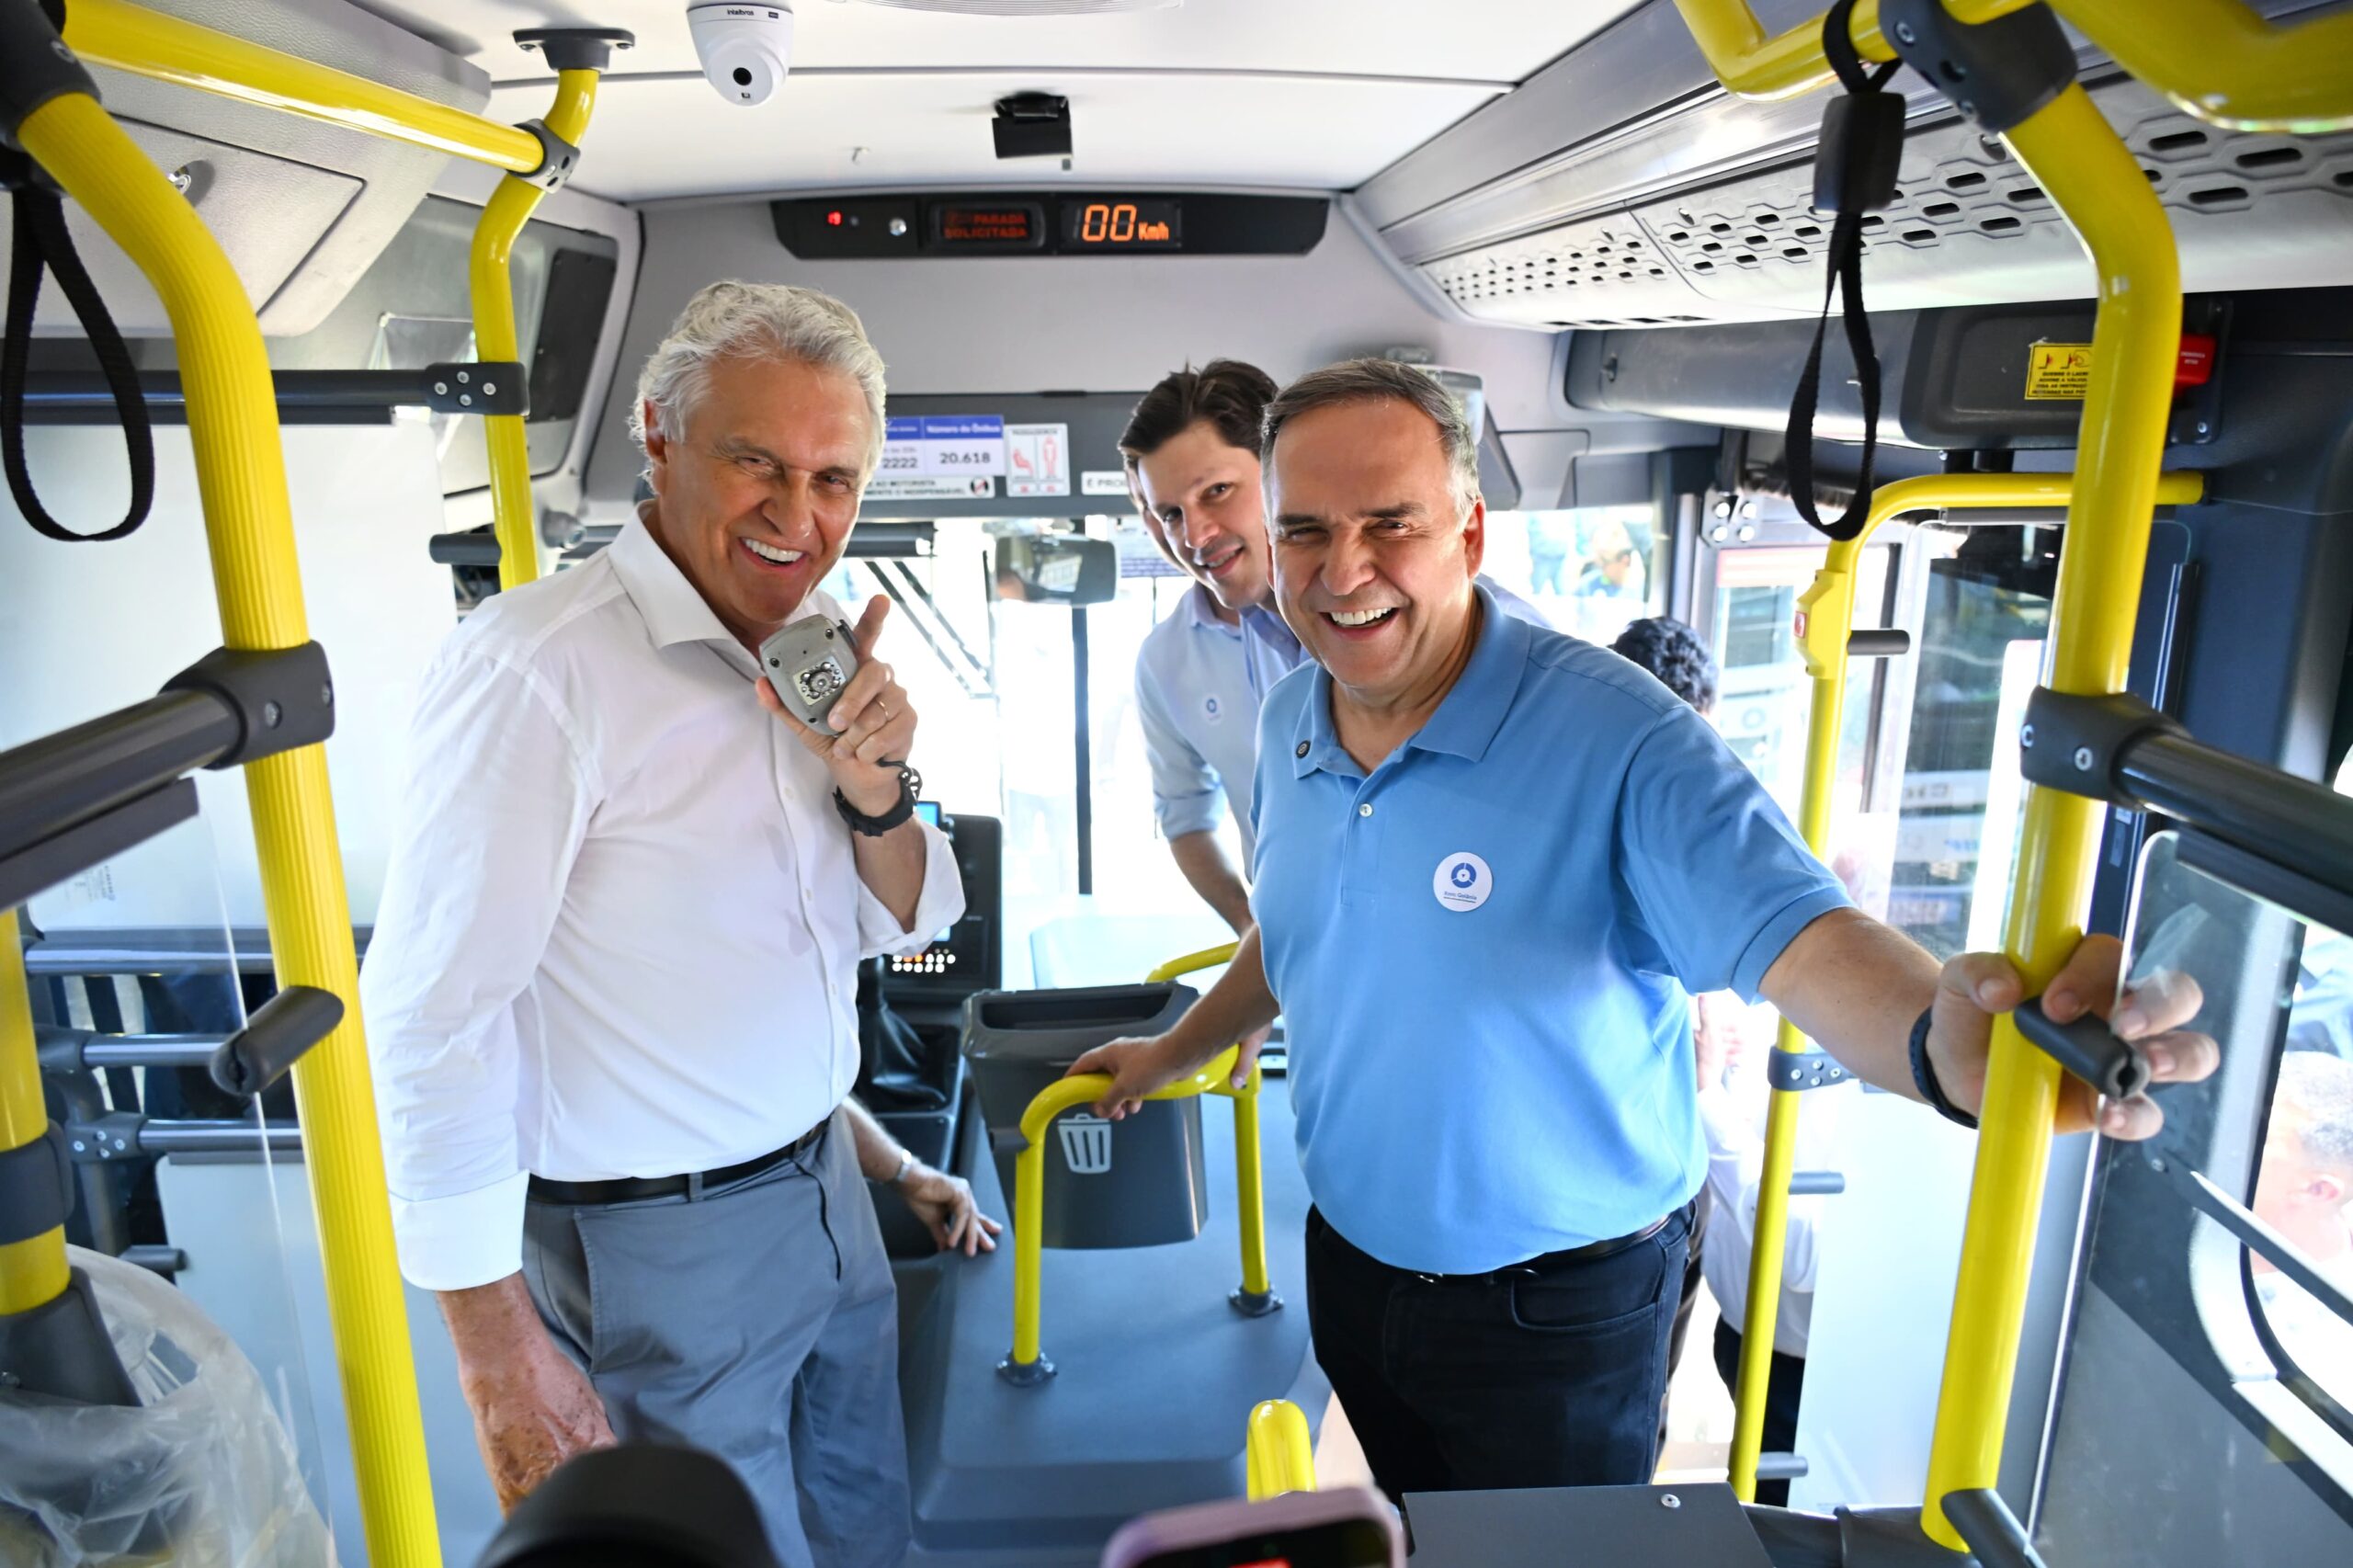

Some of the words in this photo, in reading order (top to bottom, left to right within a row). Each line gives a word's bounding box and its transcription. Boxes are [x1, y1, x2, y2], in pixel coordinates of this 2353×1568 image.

[1082, 204, 1137, 242] 00
[926, 425, 959, 434] Número
[959, 425, 972, 433] do
[972, 422, 1001, 433] Ônibus
[939, 452, 991, 464] 20.618
